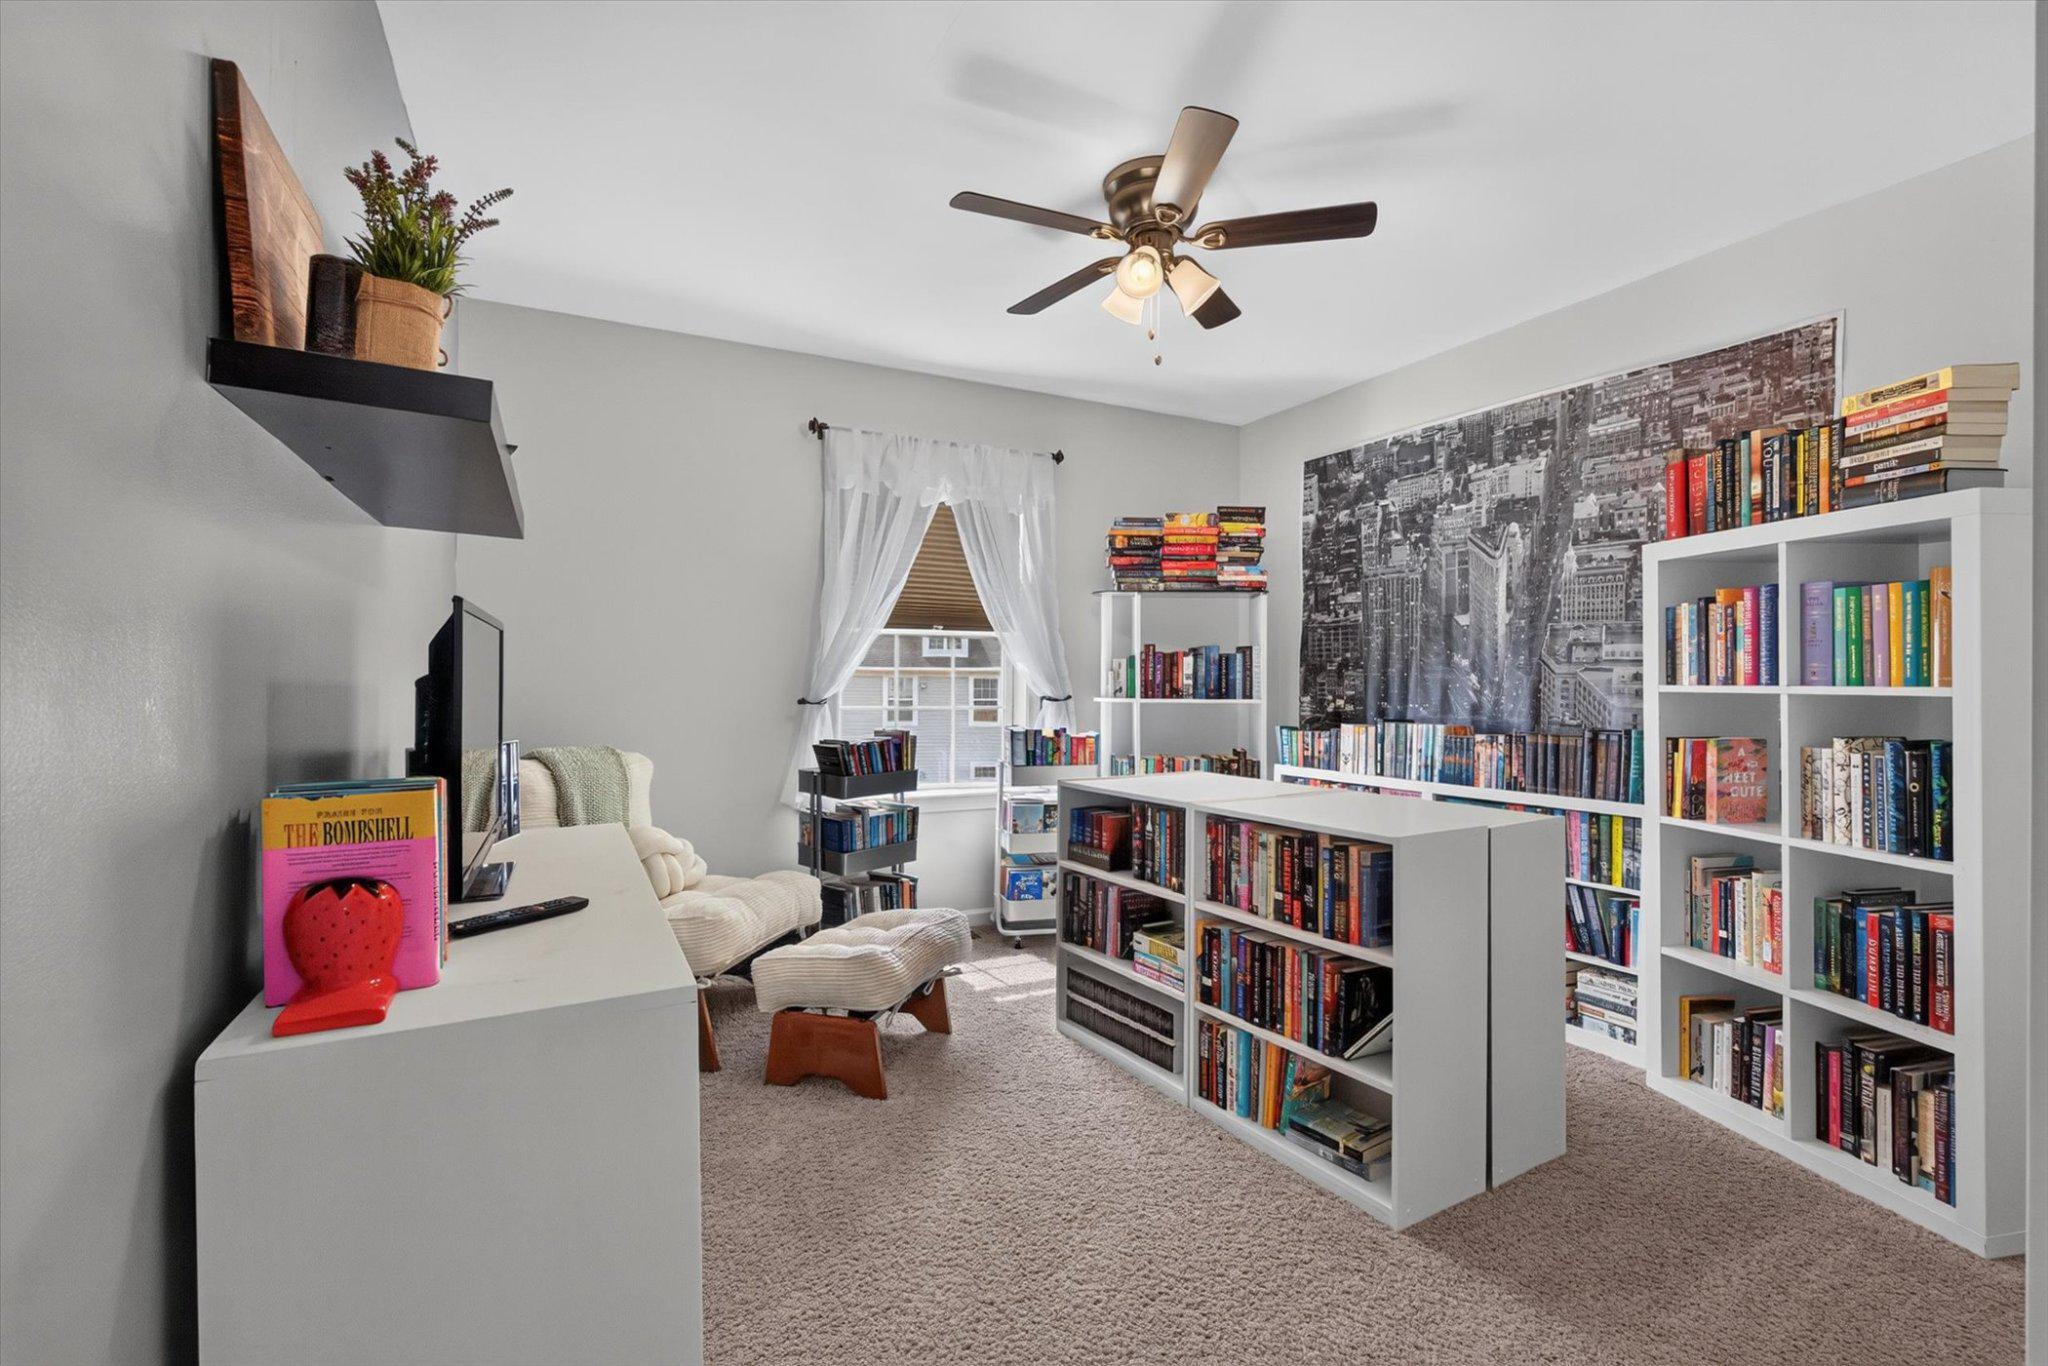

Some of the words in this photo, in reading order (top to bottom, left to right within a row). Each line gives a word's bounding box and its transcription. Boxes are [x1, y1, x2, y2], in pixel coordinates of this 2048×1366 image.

[1730, 785, 1764, 797] CUTE
[316, 808, 356, 819] PRAISE
[361, 807, 383, 816] FOR
[284, 822, 318, 849] THE
[323, 816, 414, 846] BOMBSHELL
